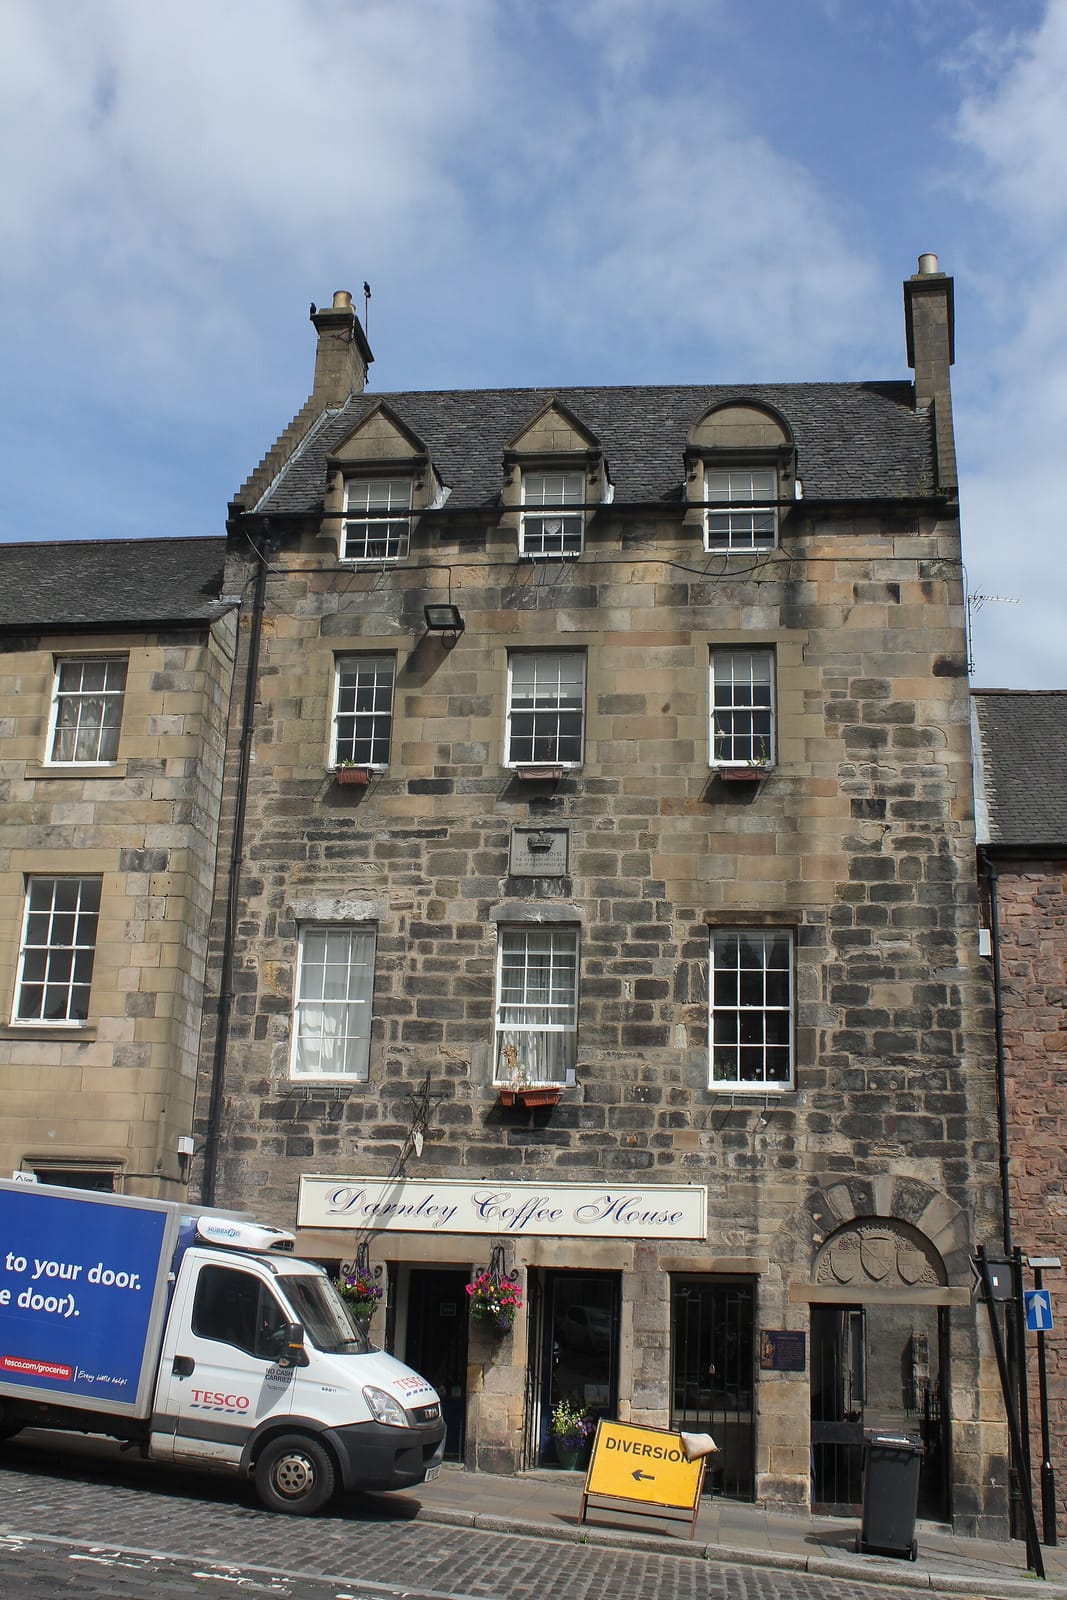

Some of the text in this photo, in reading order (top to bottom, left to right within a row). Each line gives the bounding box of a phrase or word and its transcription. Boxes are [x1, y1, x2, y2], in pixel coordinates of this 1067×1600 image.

[327, 1187, 685, 1231] Darnley Coffee House
[6, 1252, 141, 1290] to your door.
[18, 1287, 80, 1318] door).
[4, 1358, 69, 1375] tesco.com/groceries
[276, 1369, 293, 1377] CASH
[265, 1374, 292, 1383] CARRIED
[191, 1390, 250, 1408] TESCO
[605, 1437, 692, 1463] DIVERSION
